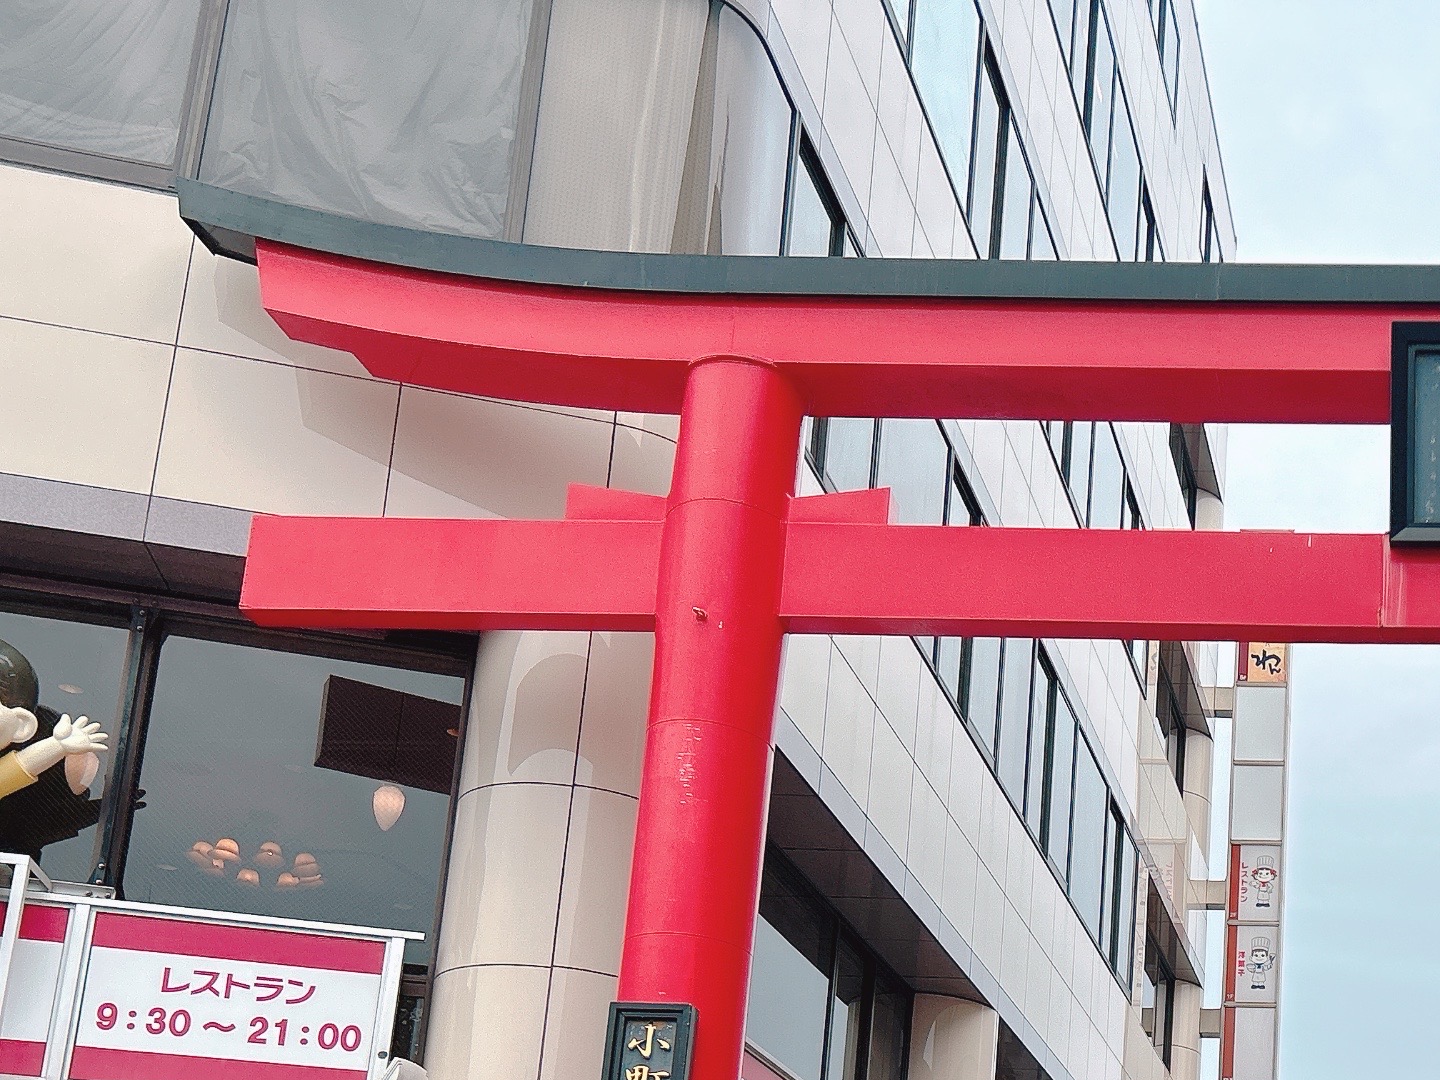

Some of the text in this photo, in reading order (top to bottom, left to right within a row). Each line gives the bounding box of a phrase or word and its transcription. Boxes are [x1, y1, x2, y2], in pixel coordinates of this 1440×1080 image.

[161, 967, 317, 1004] レストラン
